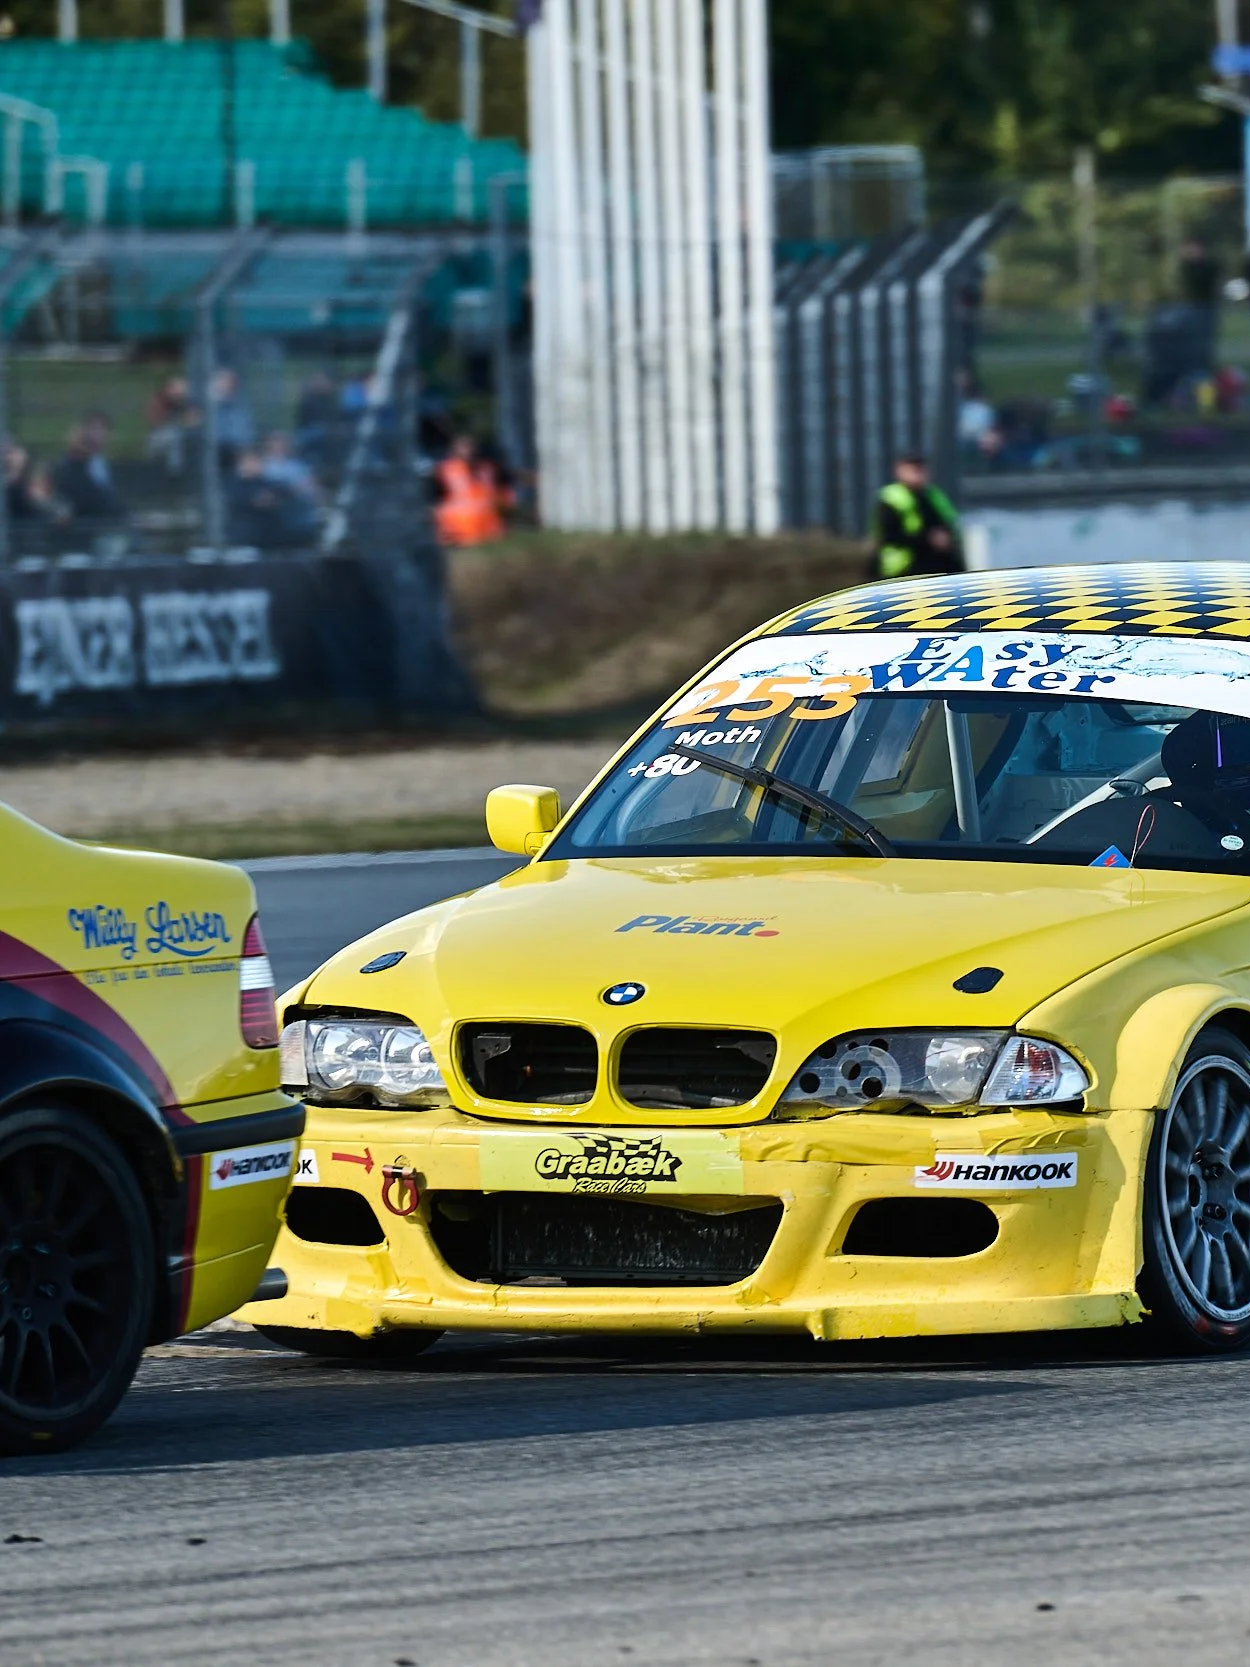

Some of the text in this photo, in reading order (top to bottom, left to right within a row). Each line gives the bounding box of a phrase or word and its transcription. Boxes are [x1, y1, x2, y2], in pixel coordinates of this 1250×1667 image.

[661, 675, 873, 730] 253
[673, 725, 762, 748] Moth
[535, 1147, 684, 1182] Graabæk
[572, 1177, 612, 1194] Race
